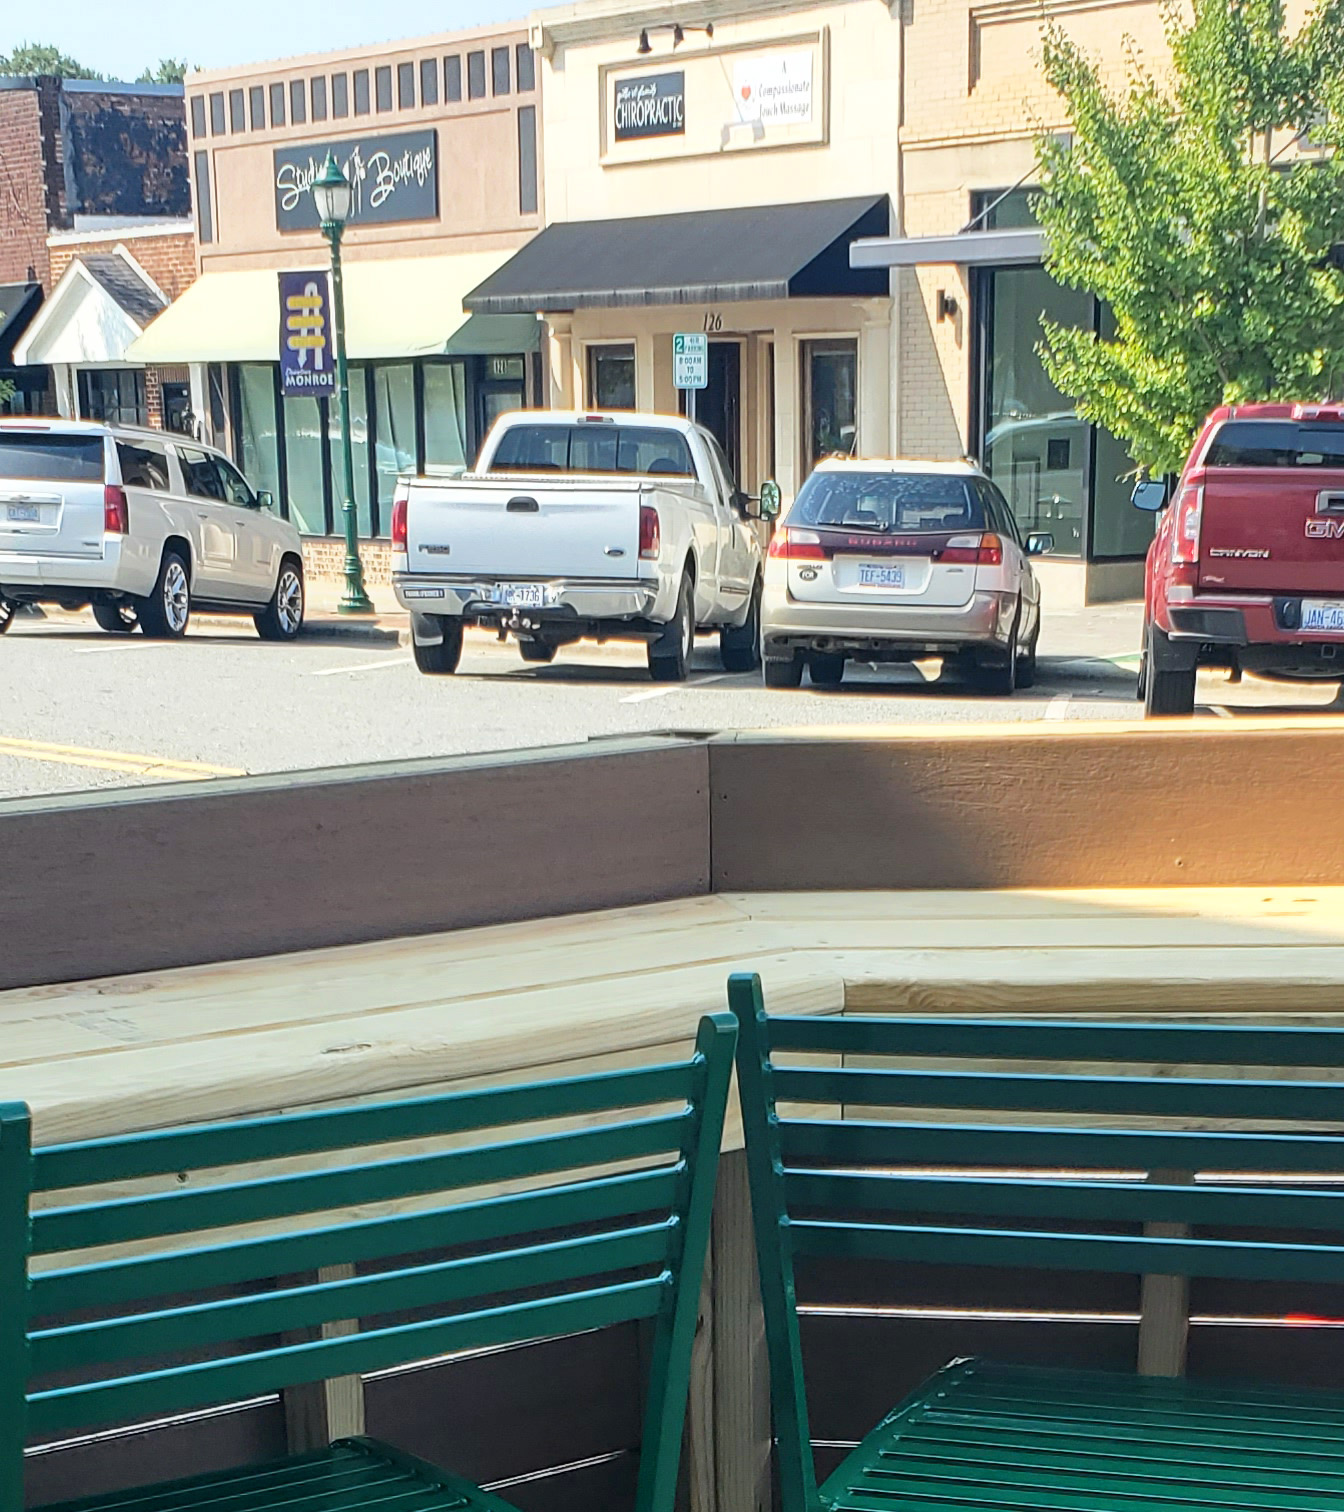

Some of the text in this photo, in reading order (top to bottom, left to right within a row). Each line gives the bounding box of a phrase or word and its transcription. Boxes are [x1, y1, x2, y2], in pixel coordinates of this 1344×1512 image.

[615, 96, 683, 129] CHIROPRACTIC
[780, 101, 810, 117] Massage
[367, 146, 433, 208] Boutique
[703, 312, 722, 331] 126
[687, 366, 694, 374] TO
[286, 373, 333, 387] MONROE
[1209, 547, 1270, 559] CANYON
[860, 569, 902, 583] TEF-5439
